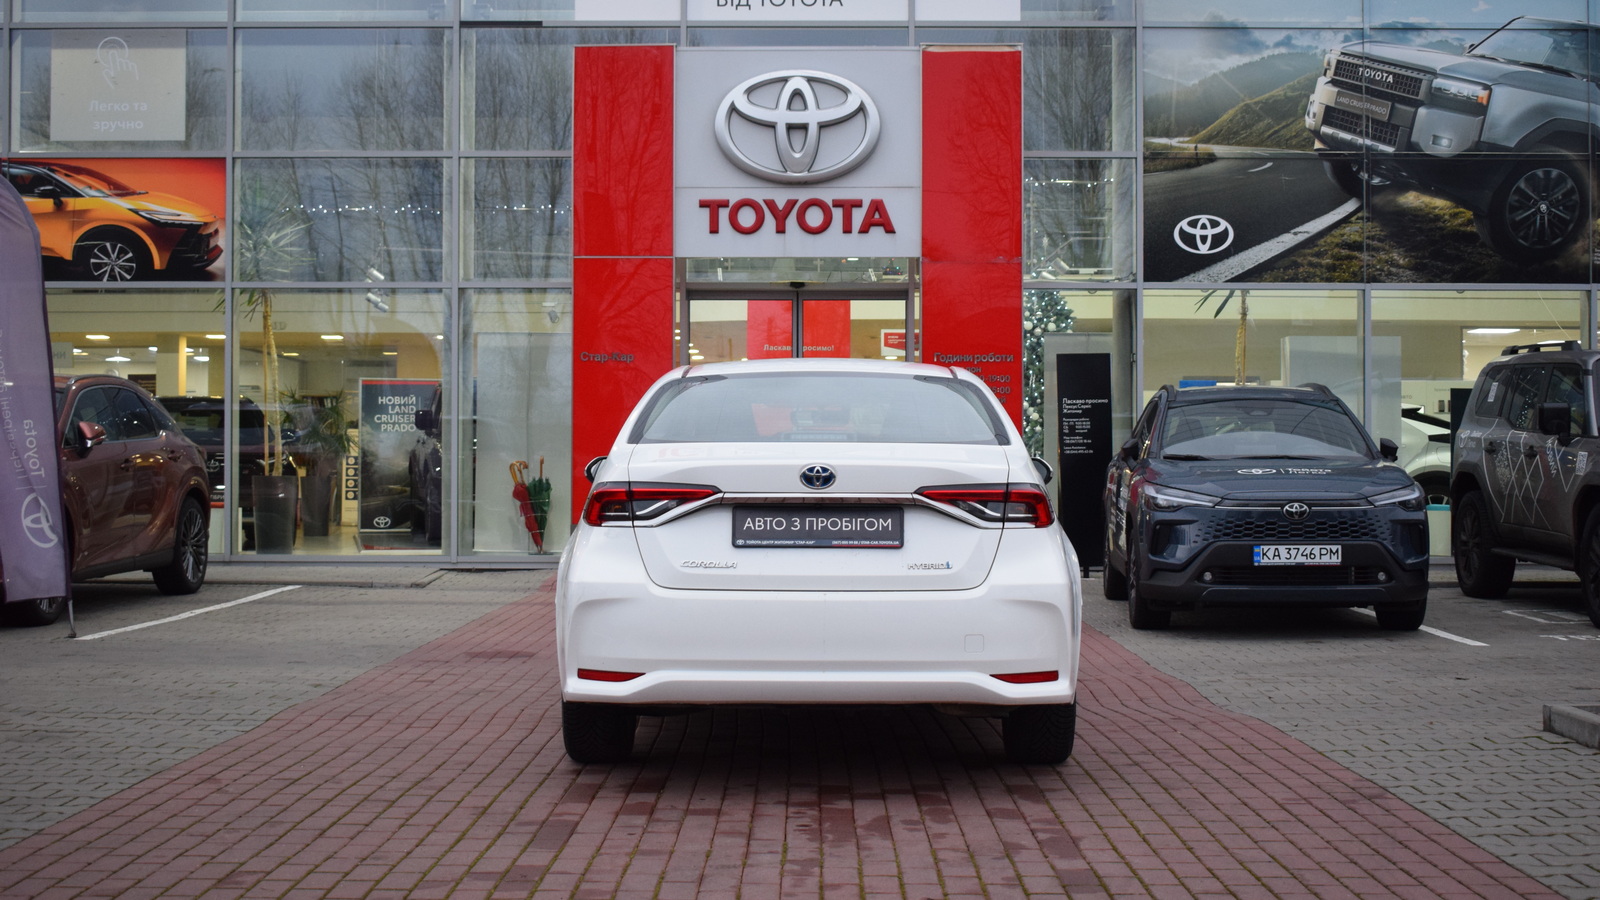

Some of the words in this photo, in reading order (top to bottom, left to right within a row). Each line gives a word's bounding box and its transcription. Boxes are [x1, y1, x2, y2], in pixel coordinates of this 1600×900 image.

[1358, 68, 1393, 83] TOYOTA
[89, 100, 129, 111] Легко
[134, 102, 147, 111] та
[1337, 96, 1349, 104] LAND
[1350, 99, 1370, 110] CRUISER
[1370, 104, 1387, 114] PRADO
[93, 120, 143, 131] зручно
[698, 198, 896, 234] TOYOTA
[580, 352, 635, 363] Стар-Кар
[934, 353, 972, 363] Години
[974, 353, 1014, 364] роботи
[378, 395, 416, 404] НОВИЙ
[388, 406, 416, 414] LAND
[374, 415, 416, 423] CRUISER
[381, 424, 416, 432] PRADO
[743, 518, 786, 531] АВТО
[790, 518, 800, 531] З
[806, 518, 892, 531] ПРОБІГОМ
[1261, 547, 1281, 560] KA
[1285, 547, 1316, 560] 3746
[1319, 547, 1339, 560] PM
[680, 559, 738, 569] COROLLA
[907, 562, 944, 570] HYBRID
